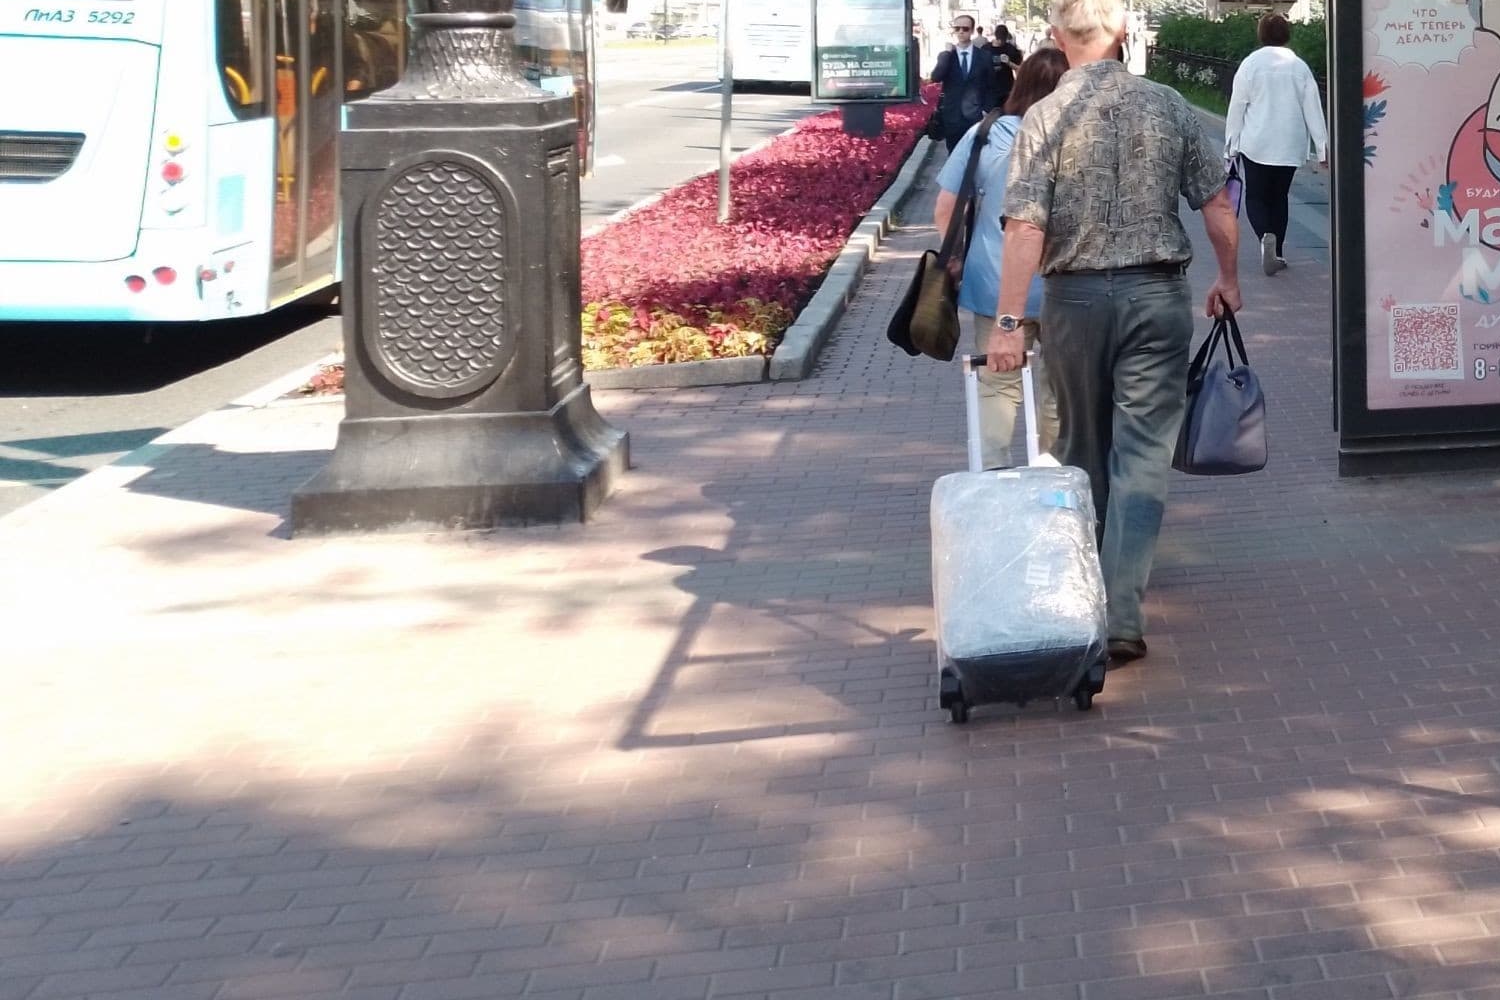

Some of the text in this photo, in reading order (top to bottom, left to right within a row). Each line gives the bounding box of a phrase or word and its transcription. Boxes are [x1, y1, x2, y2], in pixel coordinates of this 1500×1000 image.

[88, 11, 136, 25] 5292
[1412, 8, 1438, 18] ЧТО
[1384, 21, 1466, 31] МНЕ ТЕПЕРЬ
[1396, 33, 1455, 46] ДЕЛАТЬ?
